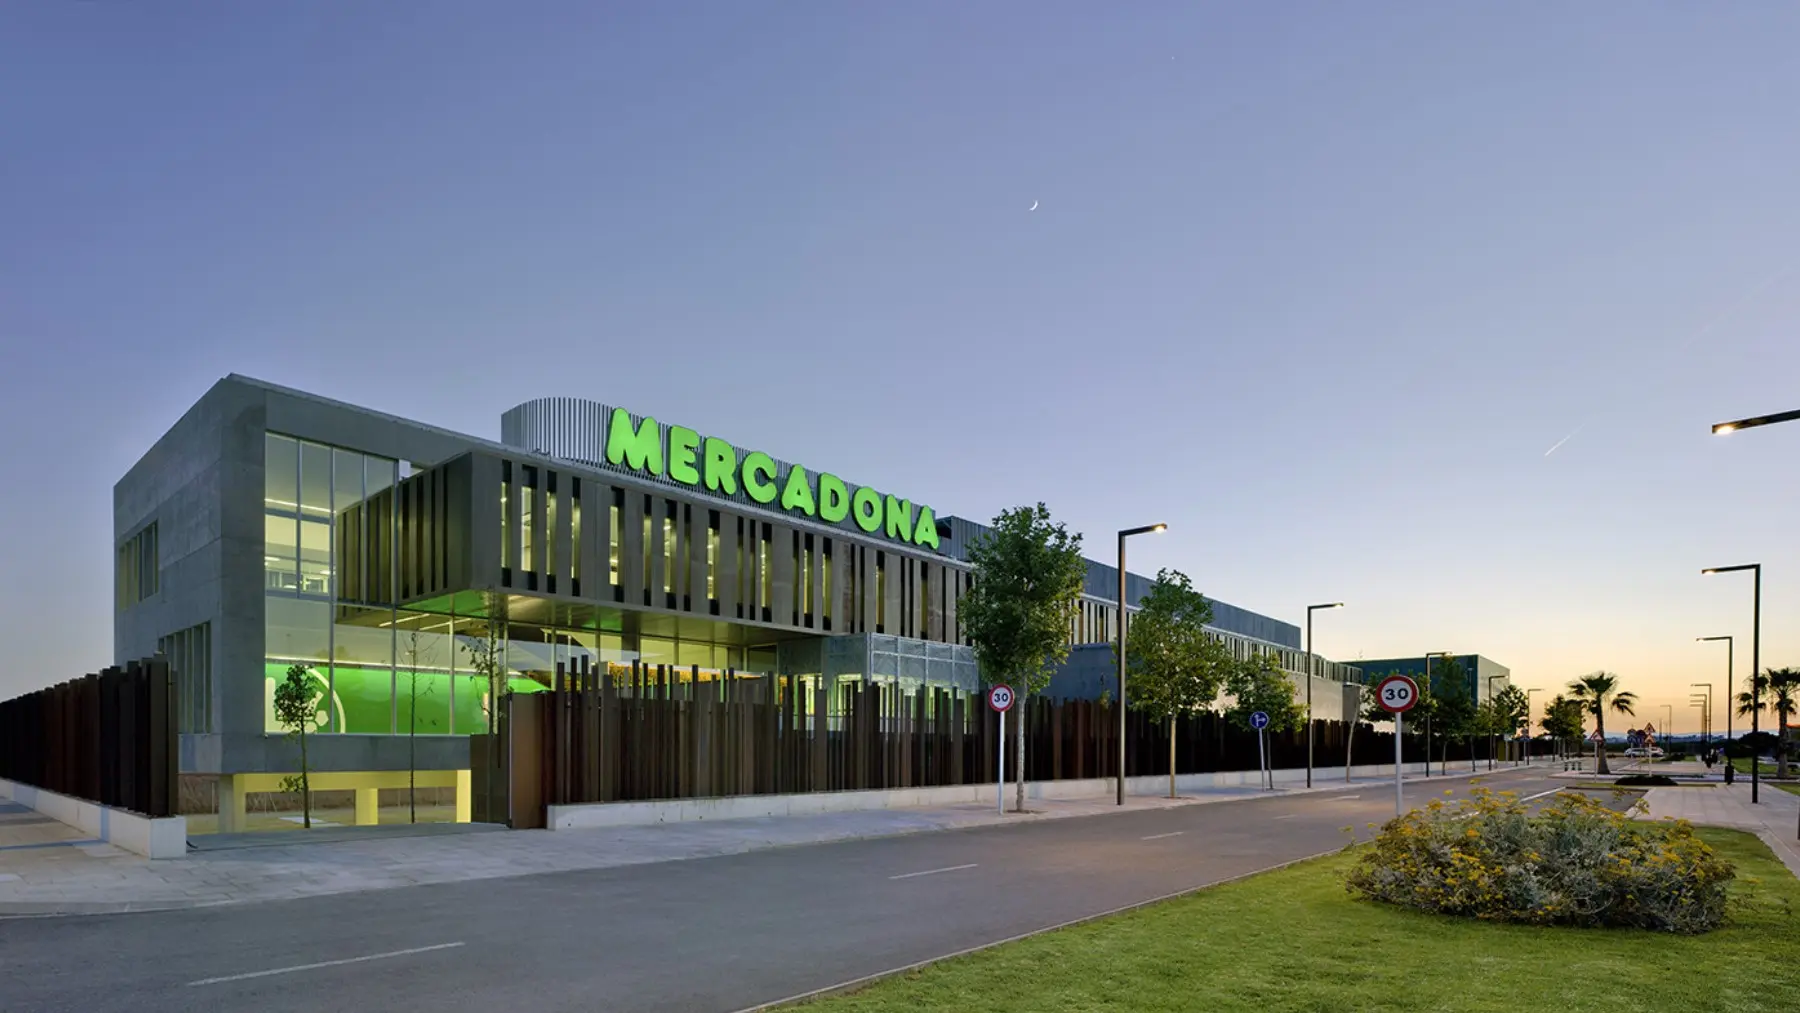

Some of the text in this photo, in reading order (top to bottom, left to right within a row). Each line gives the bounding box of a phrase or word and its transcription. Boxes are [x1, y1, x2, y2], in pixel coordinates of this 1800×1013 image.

[607, 408, 940, 549] MERCADONA
[994, 693, 1009, 702] 30
[1385, 688, 1409, 700] 30
